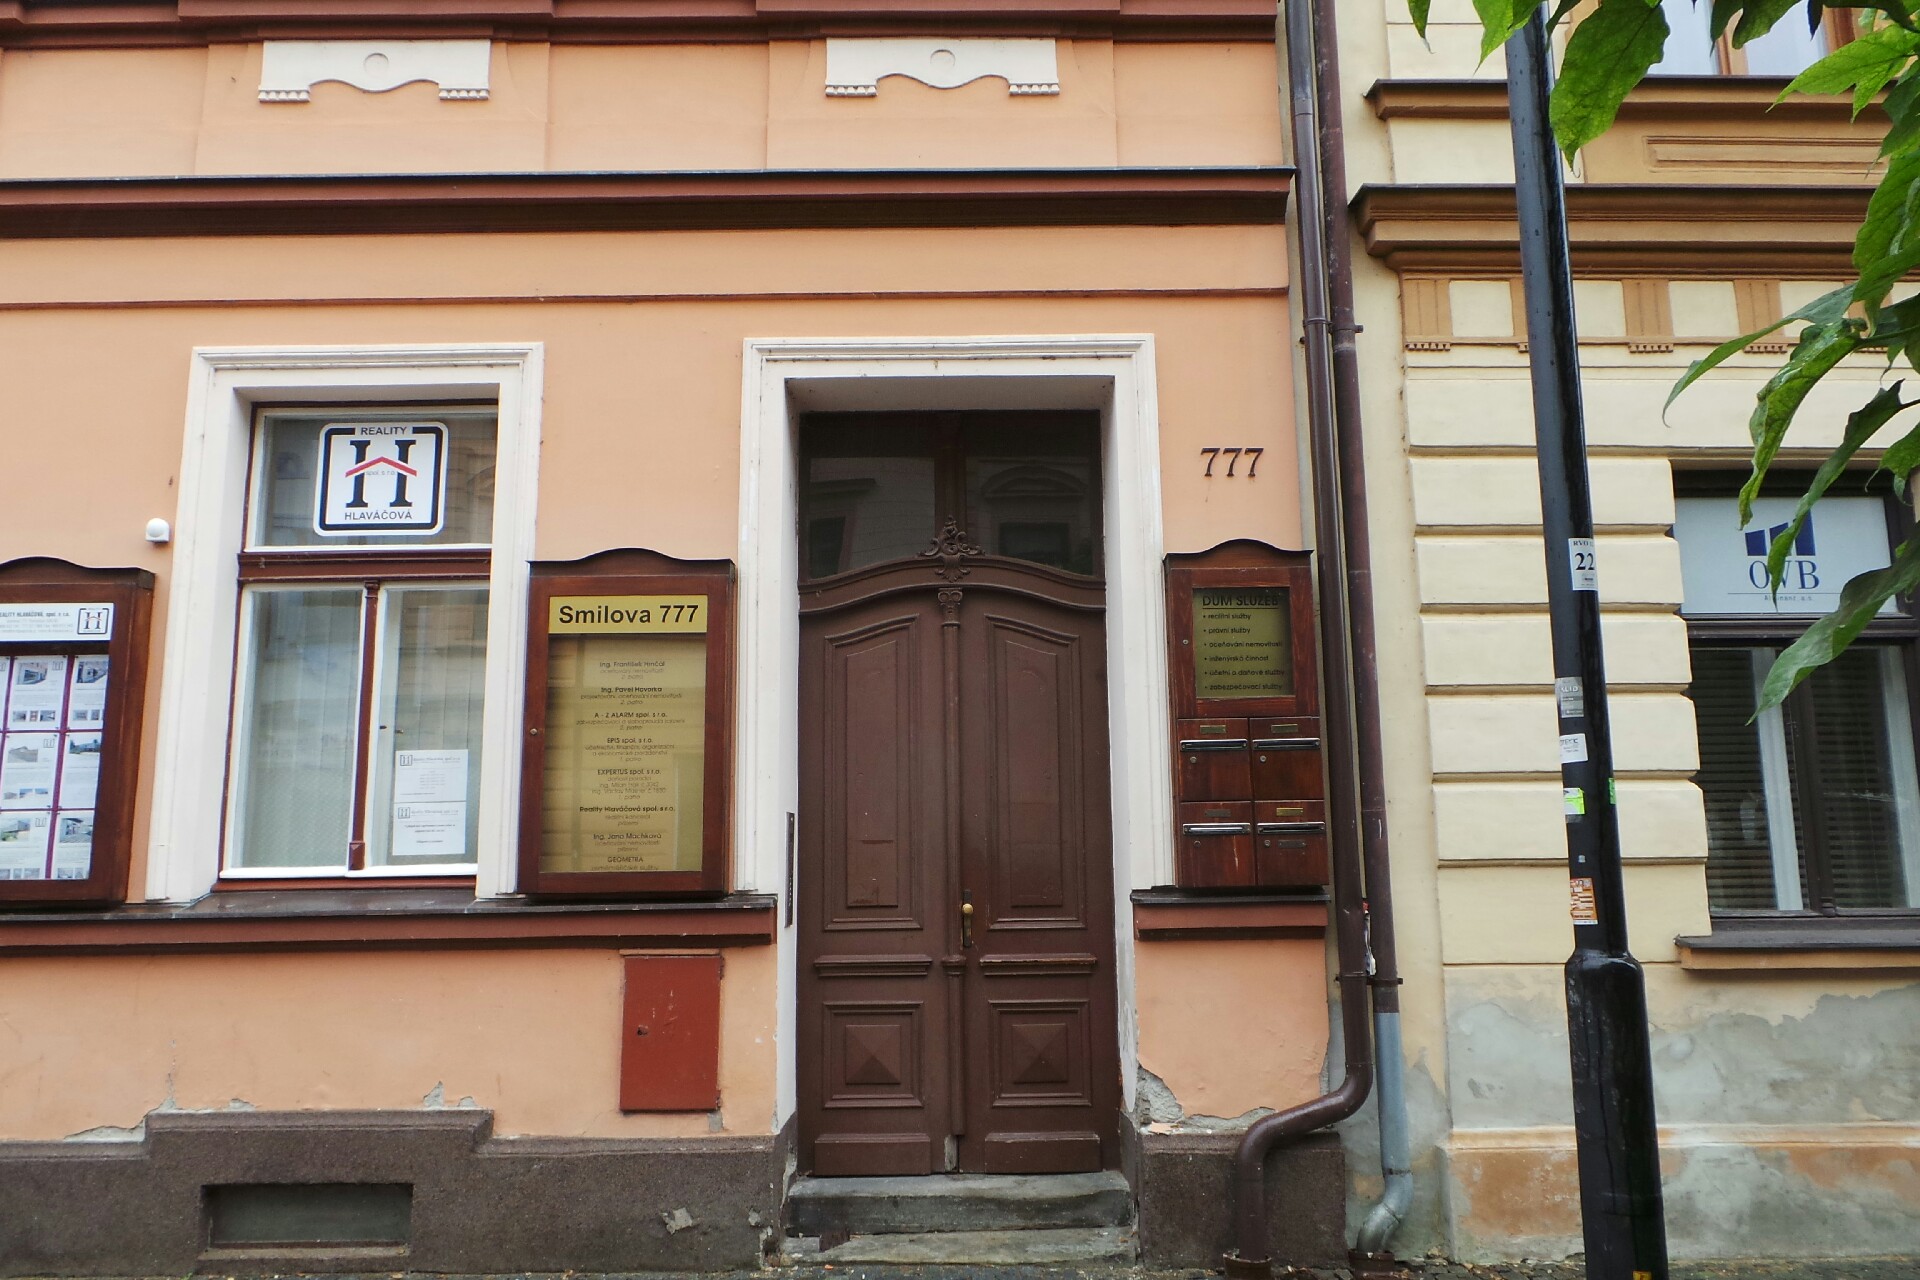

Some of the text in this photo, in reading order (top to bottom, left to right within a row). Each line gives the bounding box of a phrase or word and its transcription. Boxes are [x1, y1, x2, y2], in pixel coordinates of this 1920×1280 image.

[361, 426, 407, 435] REALITY
[1200, 448, 1264, 477] 777
[345, 510, 412, 520] HLAVÁČOVÁ
[1574, 552, 1595, 570] 22
[1749, 560, 1820, 589] OVB
[559, 605, 698, 623] Smilova 777
